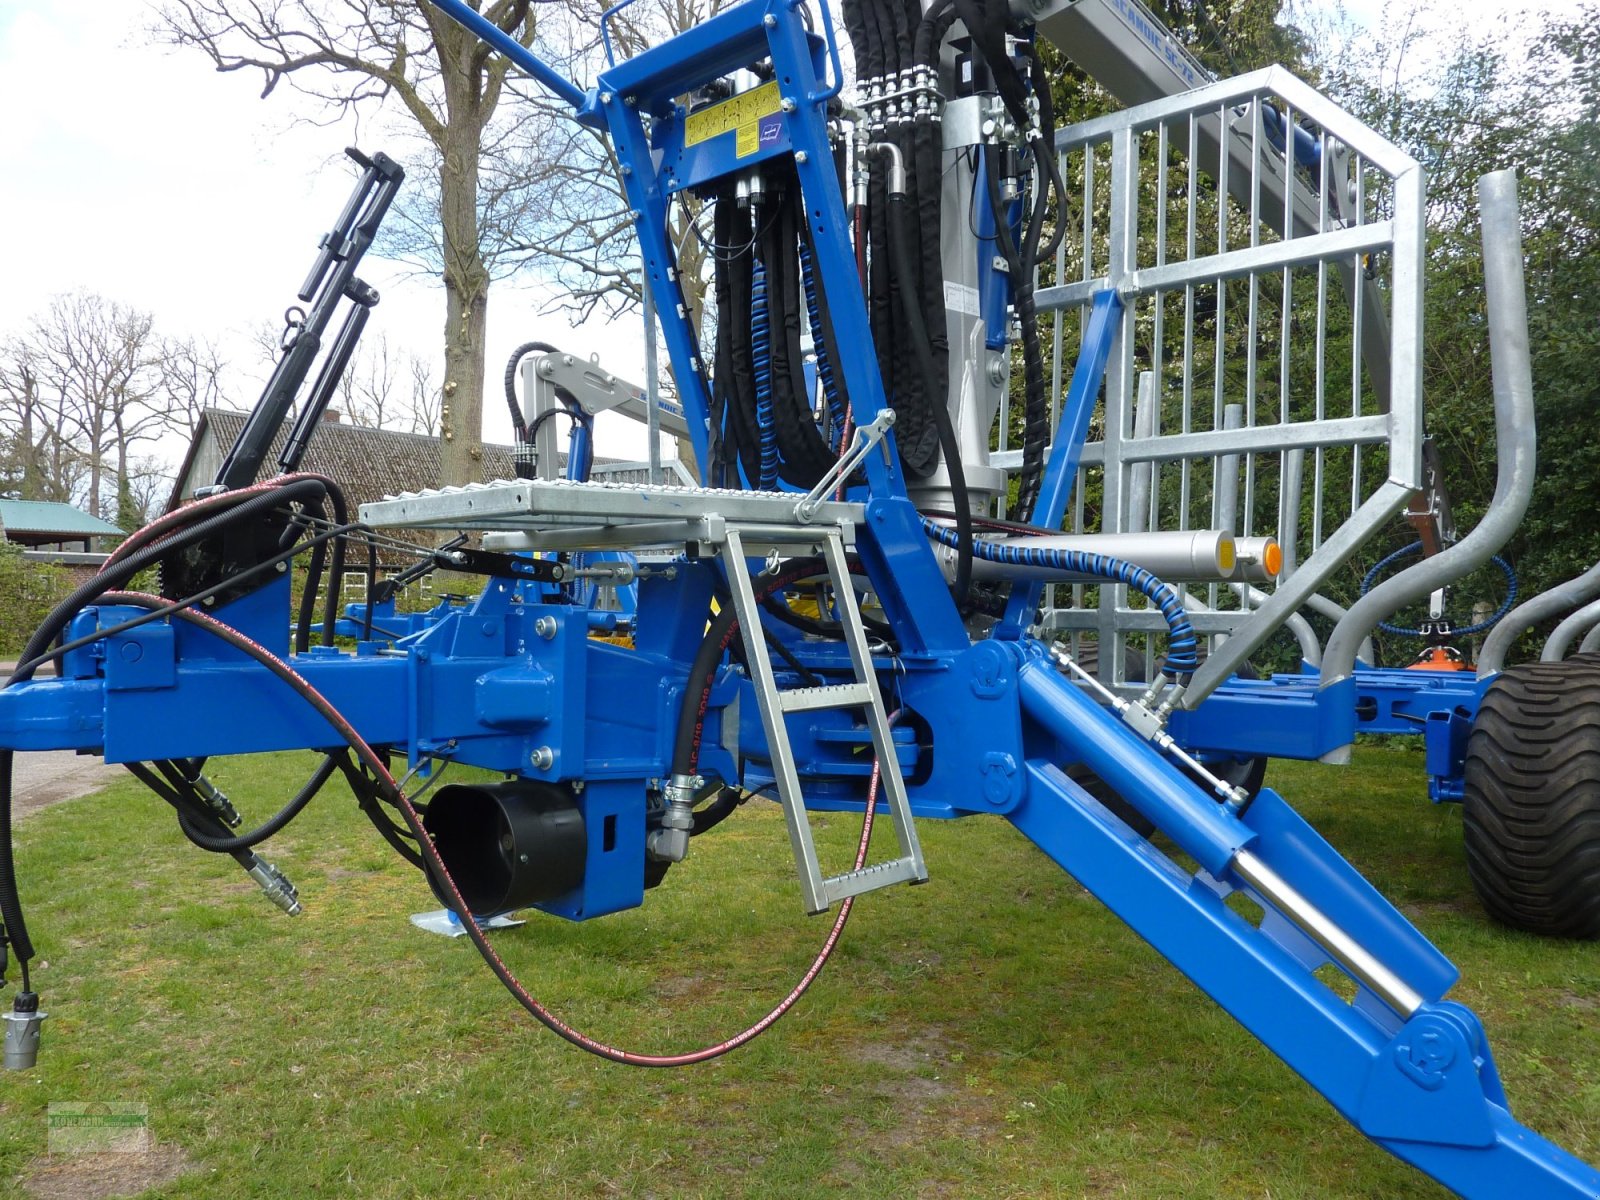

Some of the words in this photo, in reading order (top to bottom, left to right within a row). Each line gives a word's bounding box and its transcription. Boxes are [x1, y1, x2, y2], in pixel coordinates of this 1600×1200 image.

[1165, 45, 1194, 84] SC-72
[754, 1006, 781, 1031] ABRASION
[723, 1027, 755, 1047] RESISTANT
